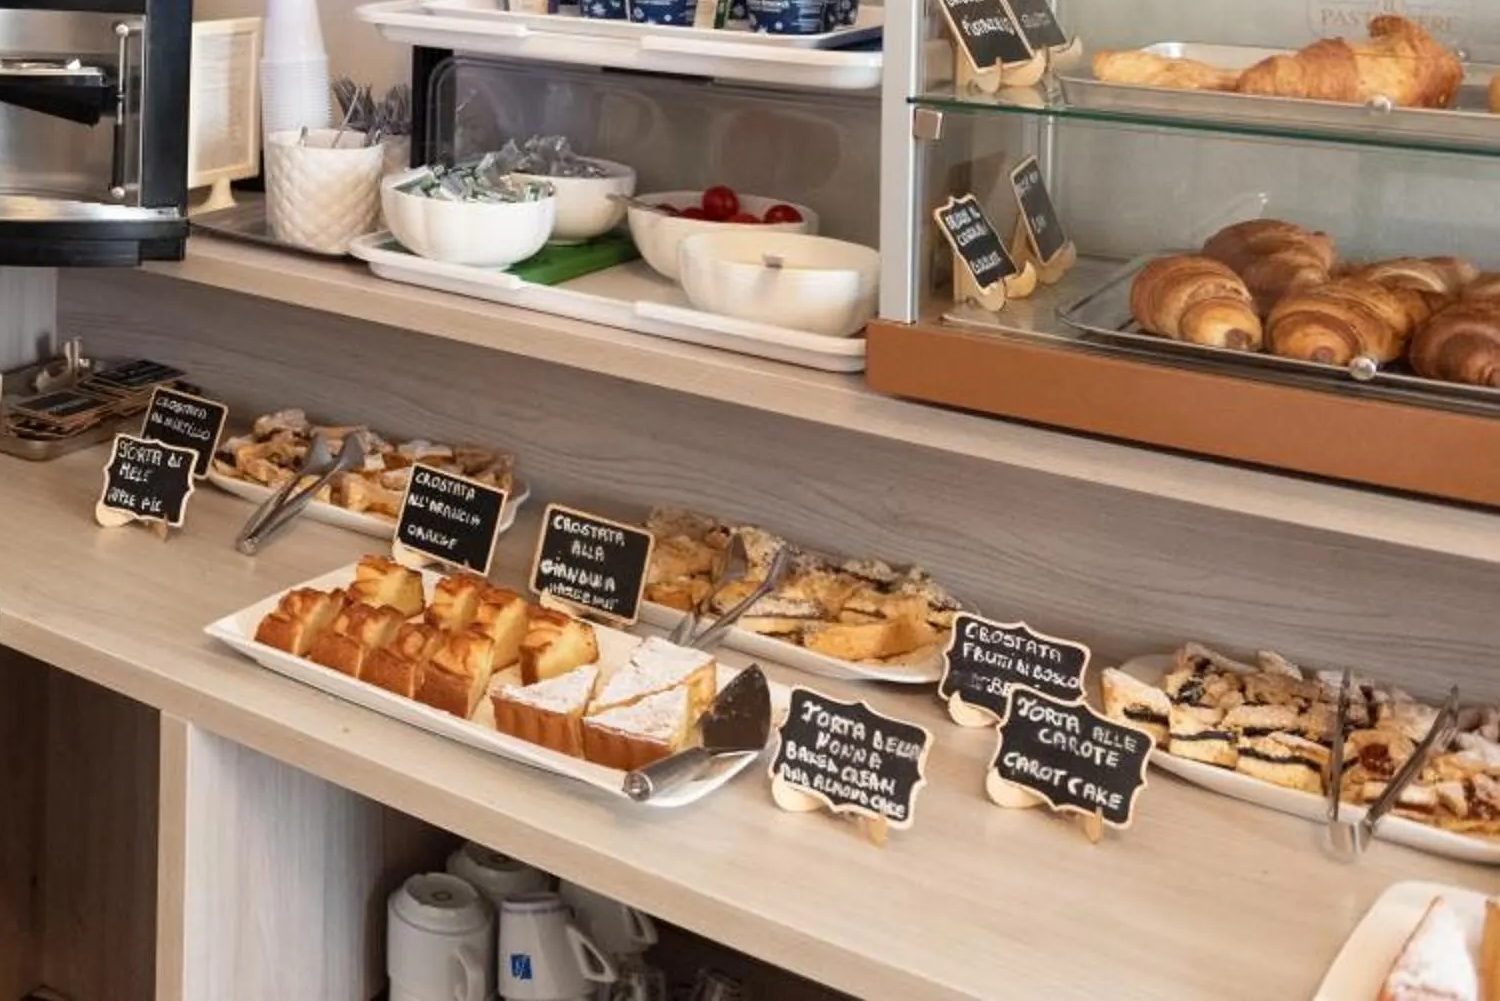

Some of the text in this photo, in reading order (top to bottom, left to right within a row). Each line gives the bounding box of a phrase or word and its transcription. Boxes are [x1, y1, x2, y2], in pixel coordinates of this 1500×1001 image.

[117, 440, 163, 466] TORTA
[119, 462, 154, 483] MELE
[141, 497, 163, 512] PIE
[414, 472, 476, 501] CROSTATA
[552, 514, 626, 547] CROSTATA
[571, 540, 606, 562] ALLA
[964, 621, 1062, 663] CROSTATA
[962, 641, 1015, 670] FRUTTI
[1016, 658, 1030, 677] DI
[1033, 664, 1080, 689] BOSCO
[800, 700, 866, 741] TORTA
[1016, 696, 1139, 754] TORTA ALLE
[785, 740, 897, 796] BAKED CREAM
[815, 730, 883, 770] NONNA
[1037, 728, 1121, 768] CAROTE
[813, 774, 869, 805] ALMOND
[869, 794, 907, 819] CAKE
[1002, 751, 1125, 811] CAROT CAKE
